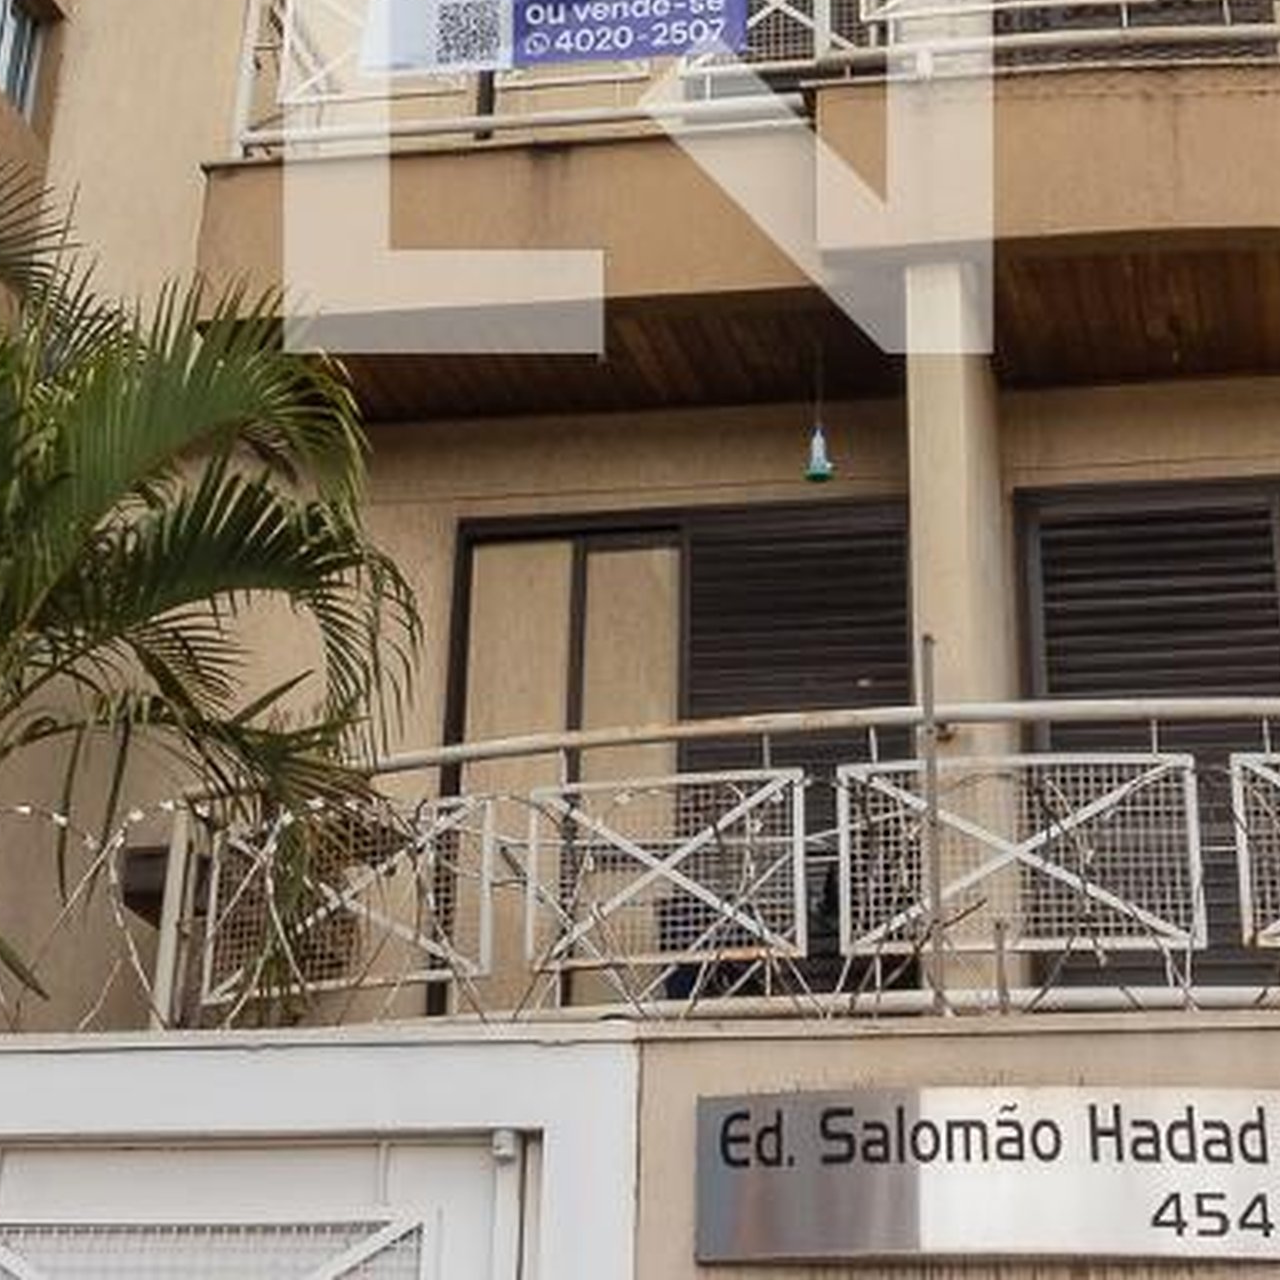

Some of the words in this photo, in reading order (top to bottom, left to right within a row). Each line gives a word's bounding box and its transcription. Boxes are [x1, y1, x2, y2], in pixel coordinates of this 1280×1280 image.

[526, 3, 565, 25] ou
[721, 1112, 796, 1168] Ed.
[820, 1104, 1063, 1164] Salomão
[1088, 1103, 1270, 1165] Hadad
[1150, 1192, 1277, 1238] 454
